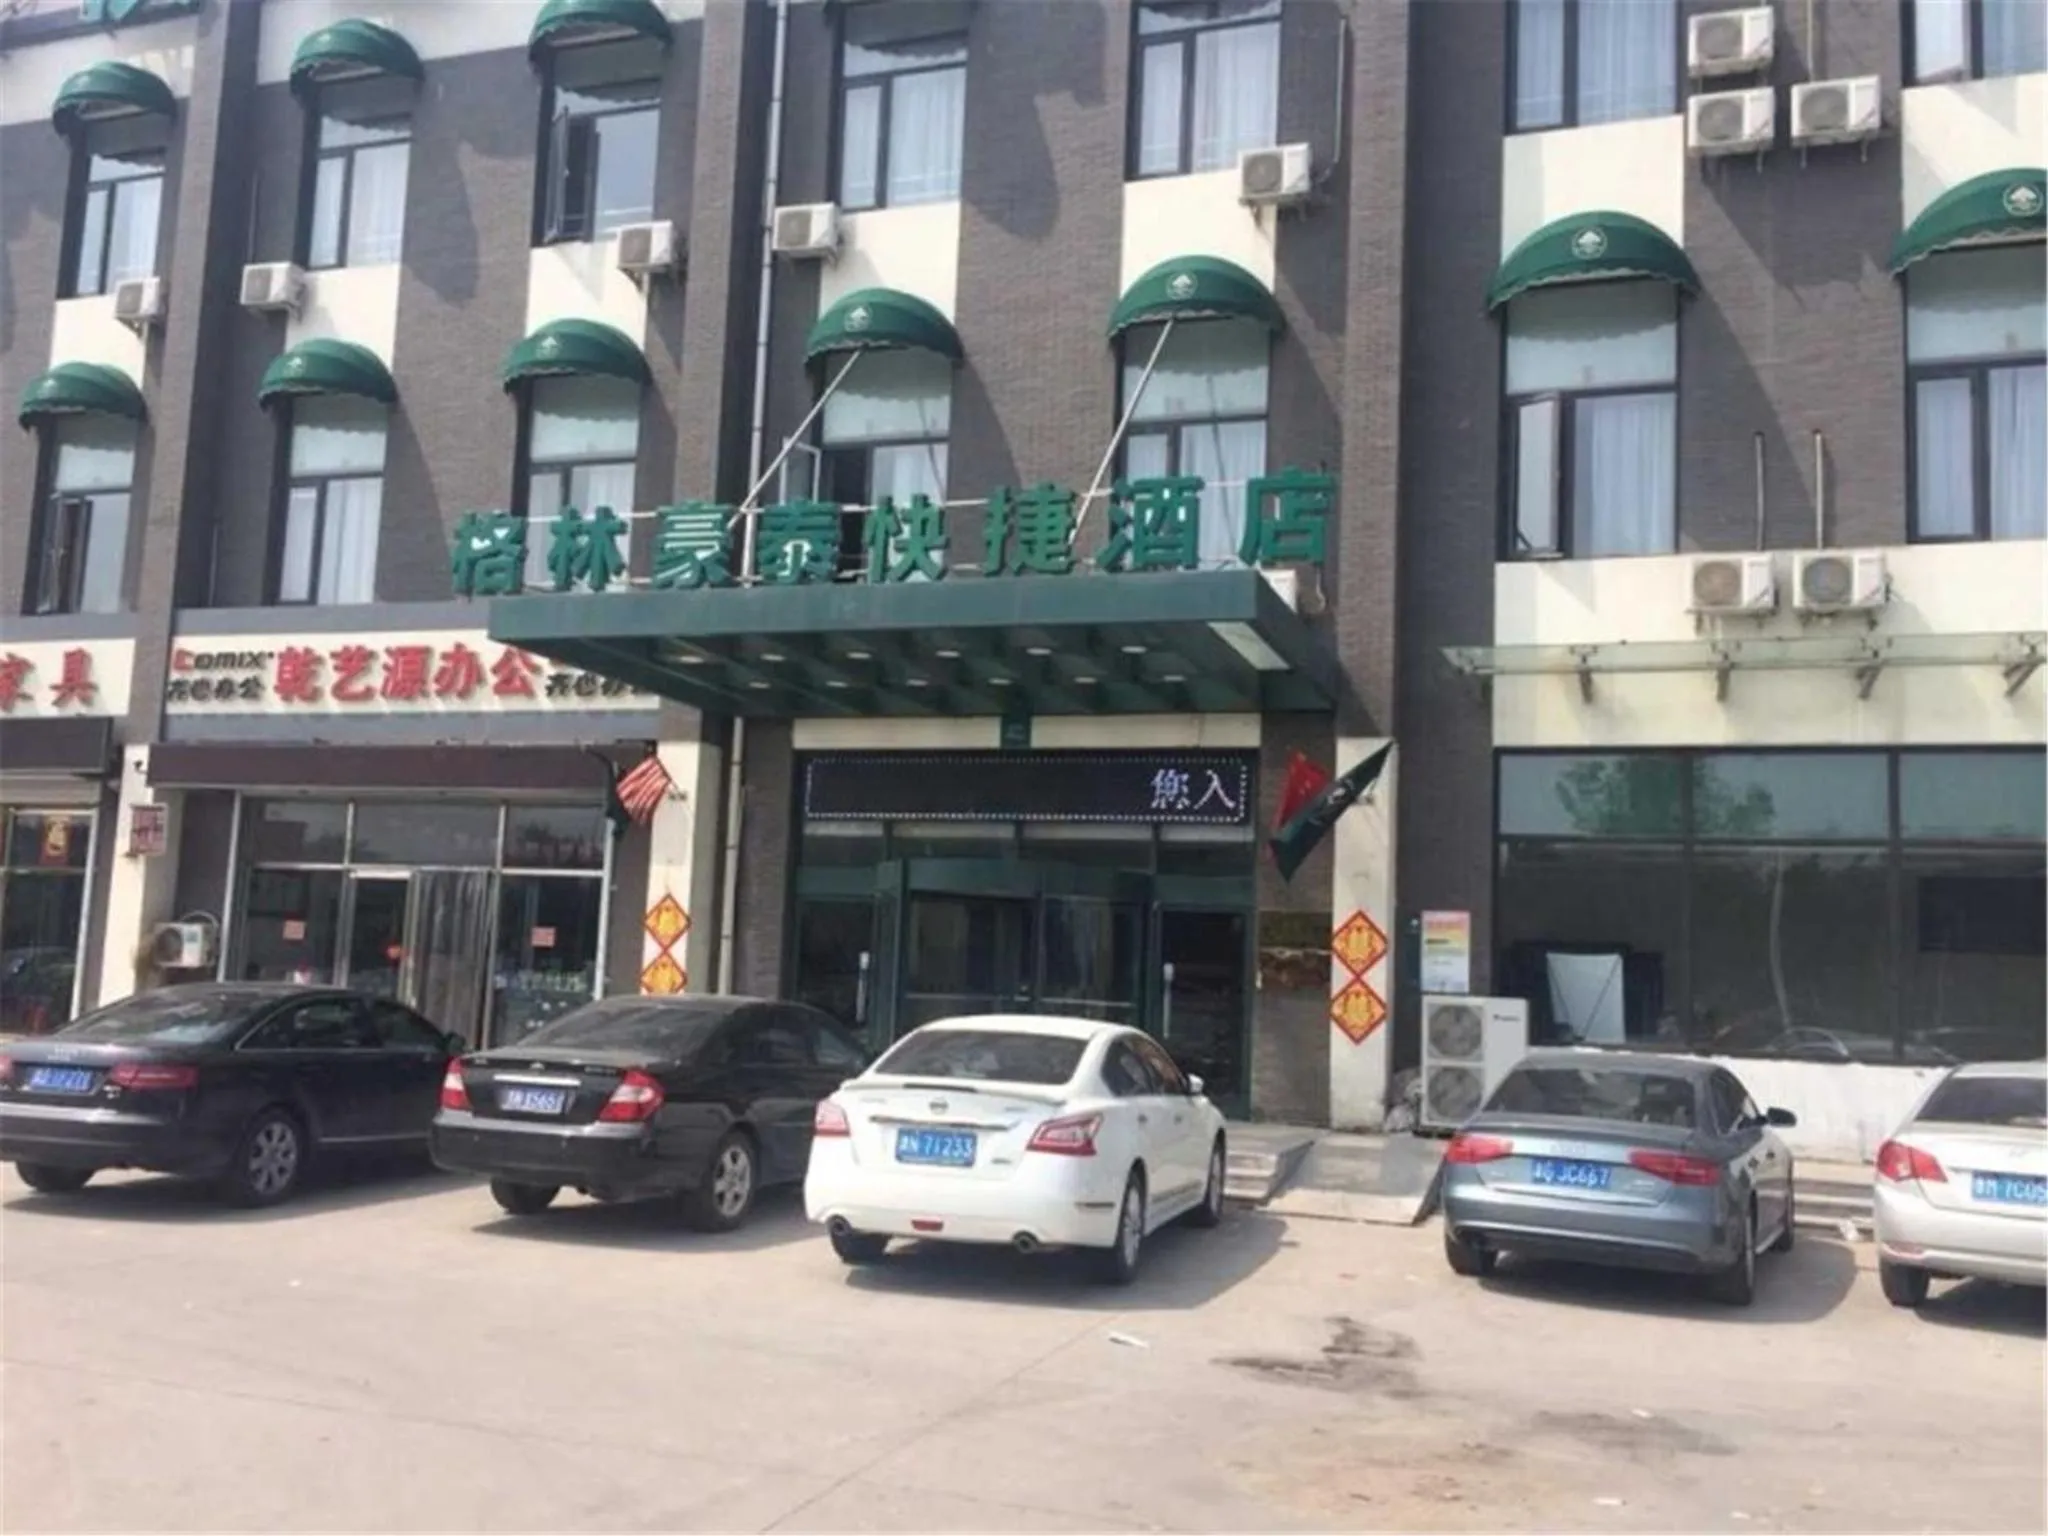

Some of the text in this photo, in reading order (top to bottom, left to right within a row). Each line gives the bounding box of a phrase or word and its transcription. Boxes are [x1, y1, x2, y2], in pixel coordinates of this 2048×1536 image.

[451, 465, 1336, 600] 格林豪泰快捷酒店
[274, 641, 542, 702] 乾艺源办公
[1151, 768, 1237, 811] 您入
